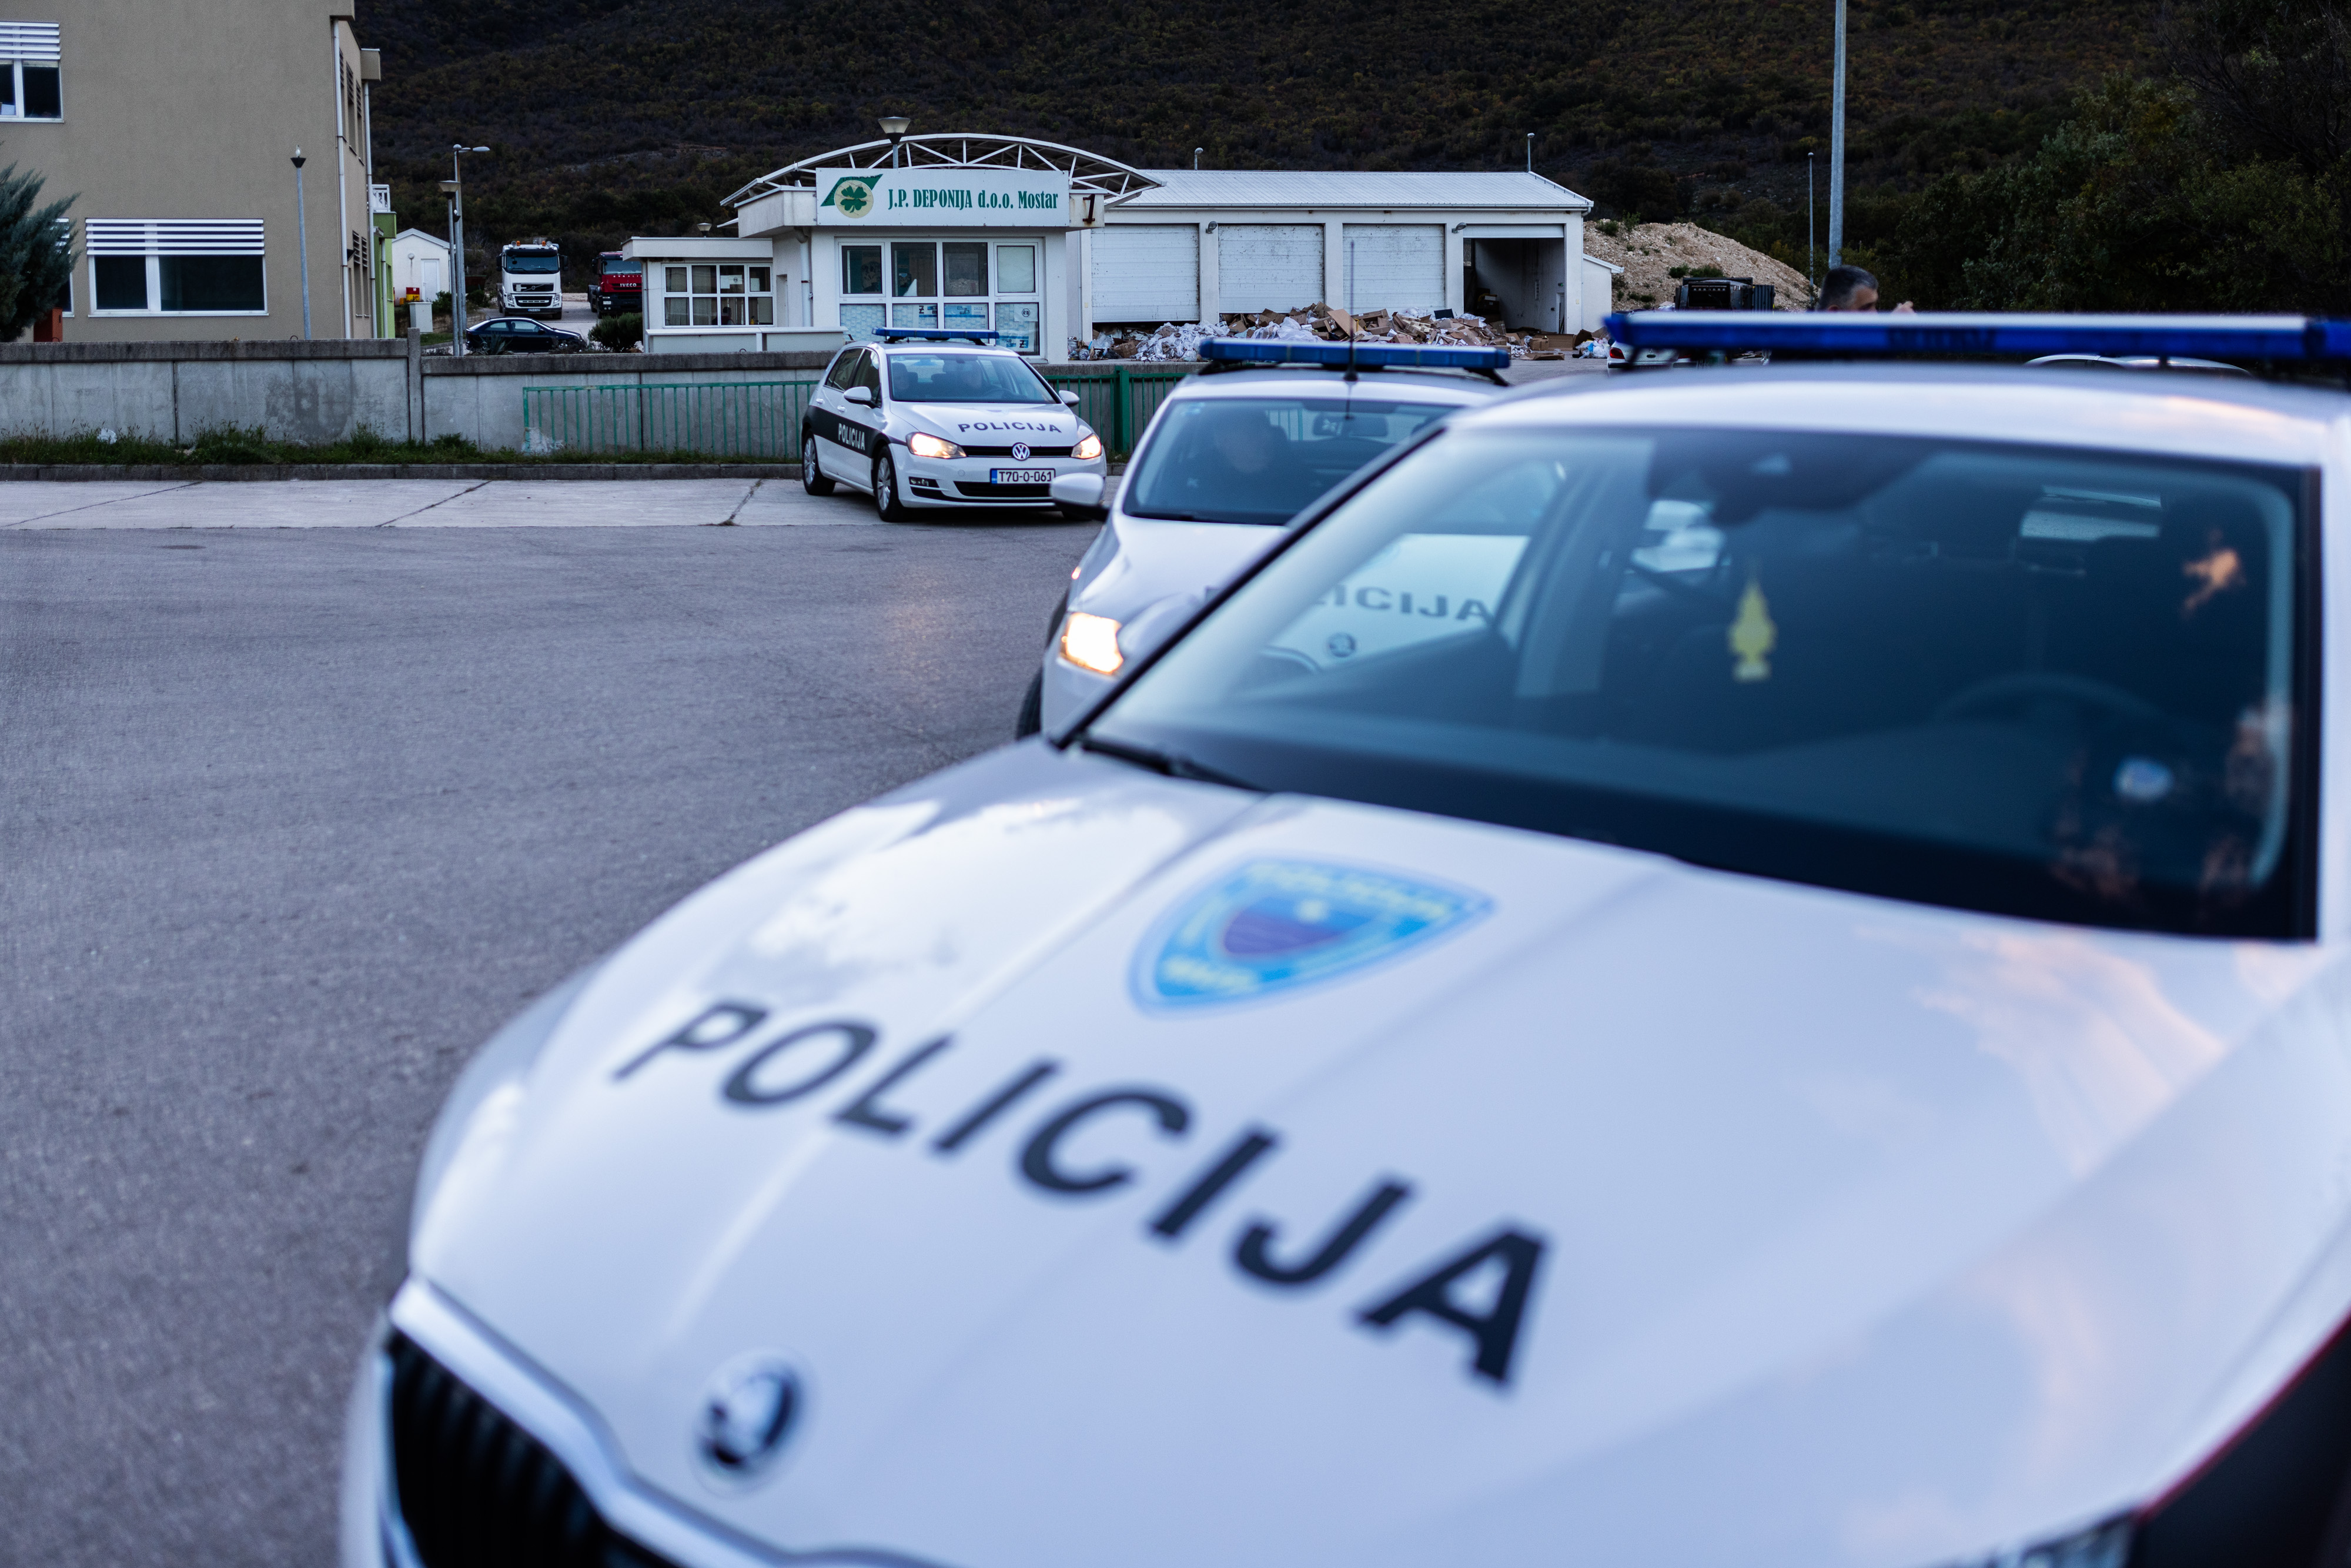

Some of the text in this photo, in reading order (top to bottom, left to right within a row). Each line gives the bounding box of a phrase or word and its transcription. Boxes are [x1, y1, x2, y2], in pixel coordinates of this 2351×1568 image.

[888, 189, 1058, 210] J.P. DEPONIJA d.o.o. Mostar
[838, 423, 865, 450] POLICIJA
[957, 422, 1062, 433] POLICIJA
[613, 998, 1551, 1392] POLICIJA
